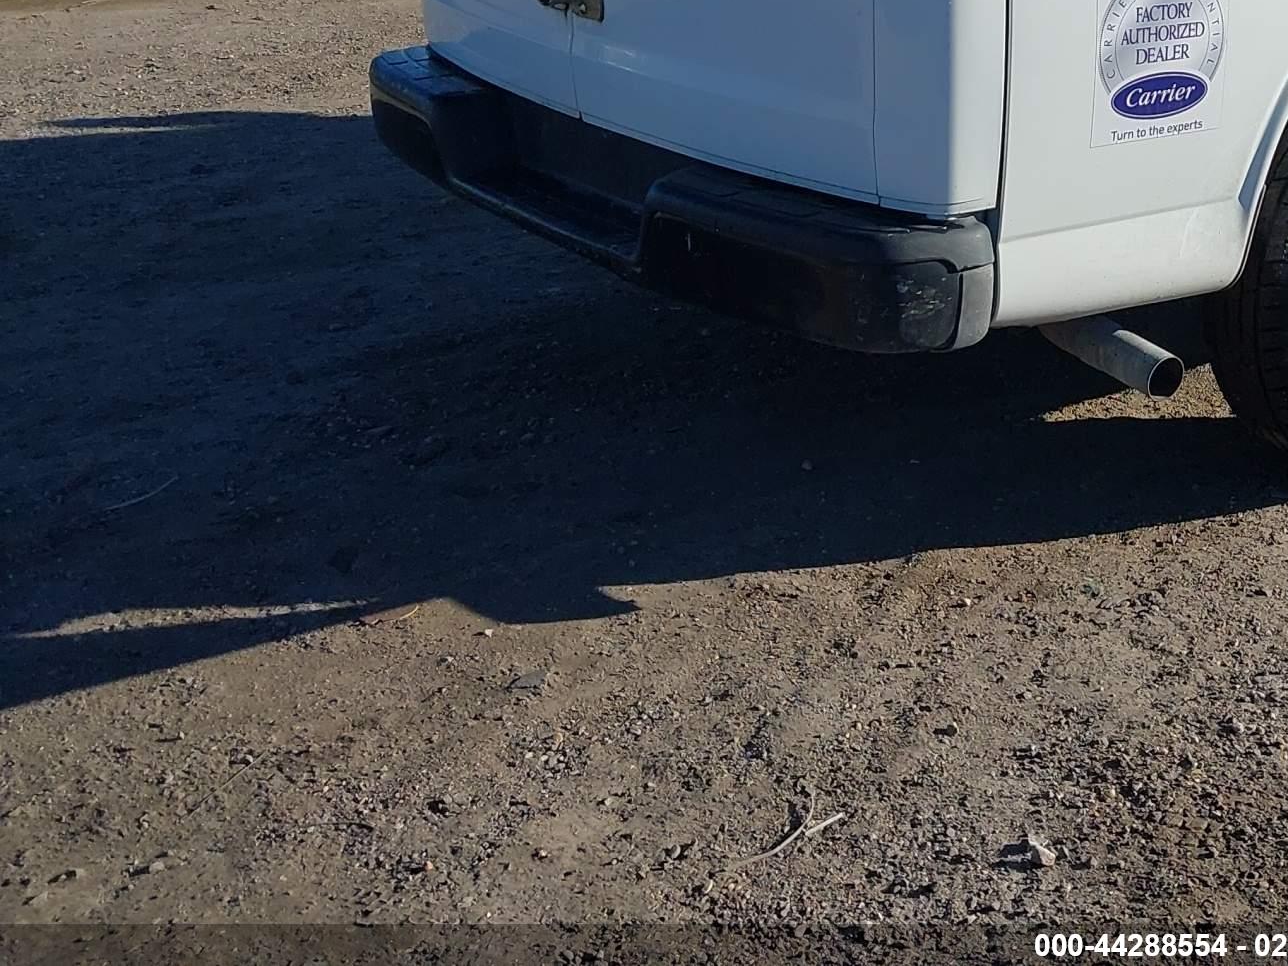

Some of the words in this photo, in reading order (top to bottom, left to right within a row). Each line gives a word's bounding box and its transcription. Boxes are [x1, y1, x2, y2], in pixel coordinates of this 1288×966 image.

[1135, 2, 1193, 23] FACTORY
[1120, 21, 1205, 46] AUTHORIZED
[1135, 44, 1190, 65] DEALER
[1125, 83, 1196, 109] Carrier
[1111, 130, 1134, 142] Turn
[1136, 127, 1147, 137] to
[1149, 124, 1165, 136] the
[1167, 119, 1203, 137] experts
